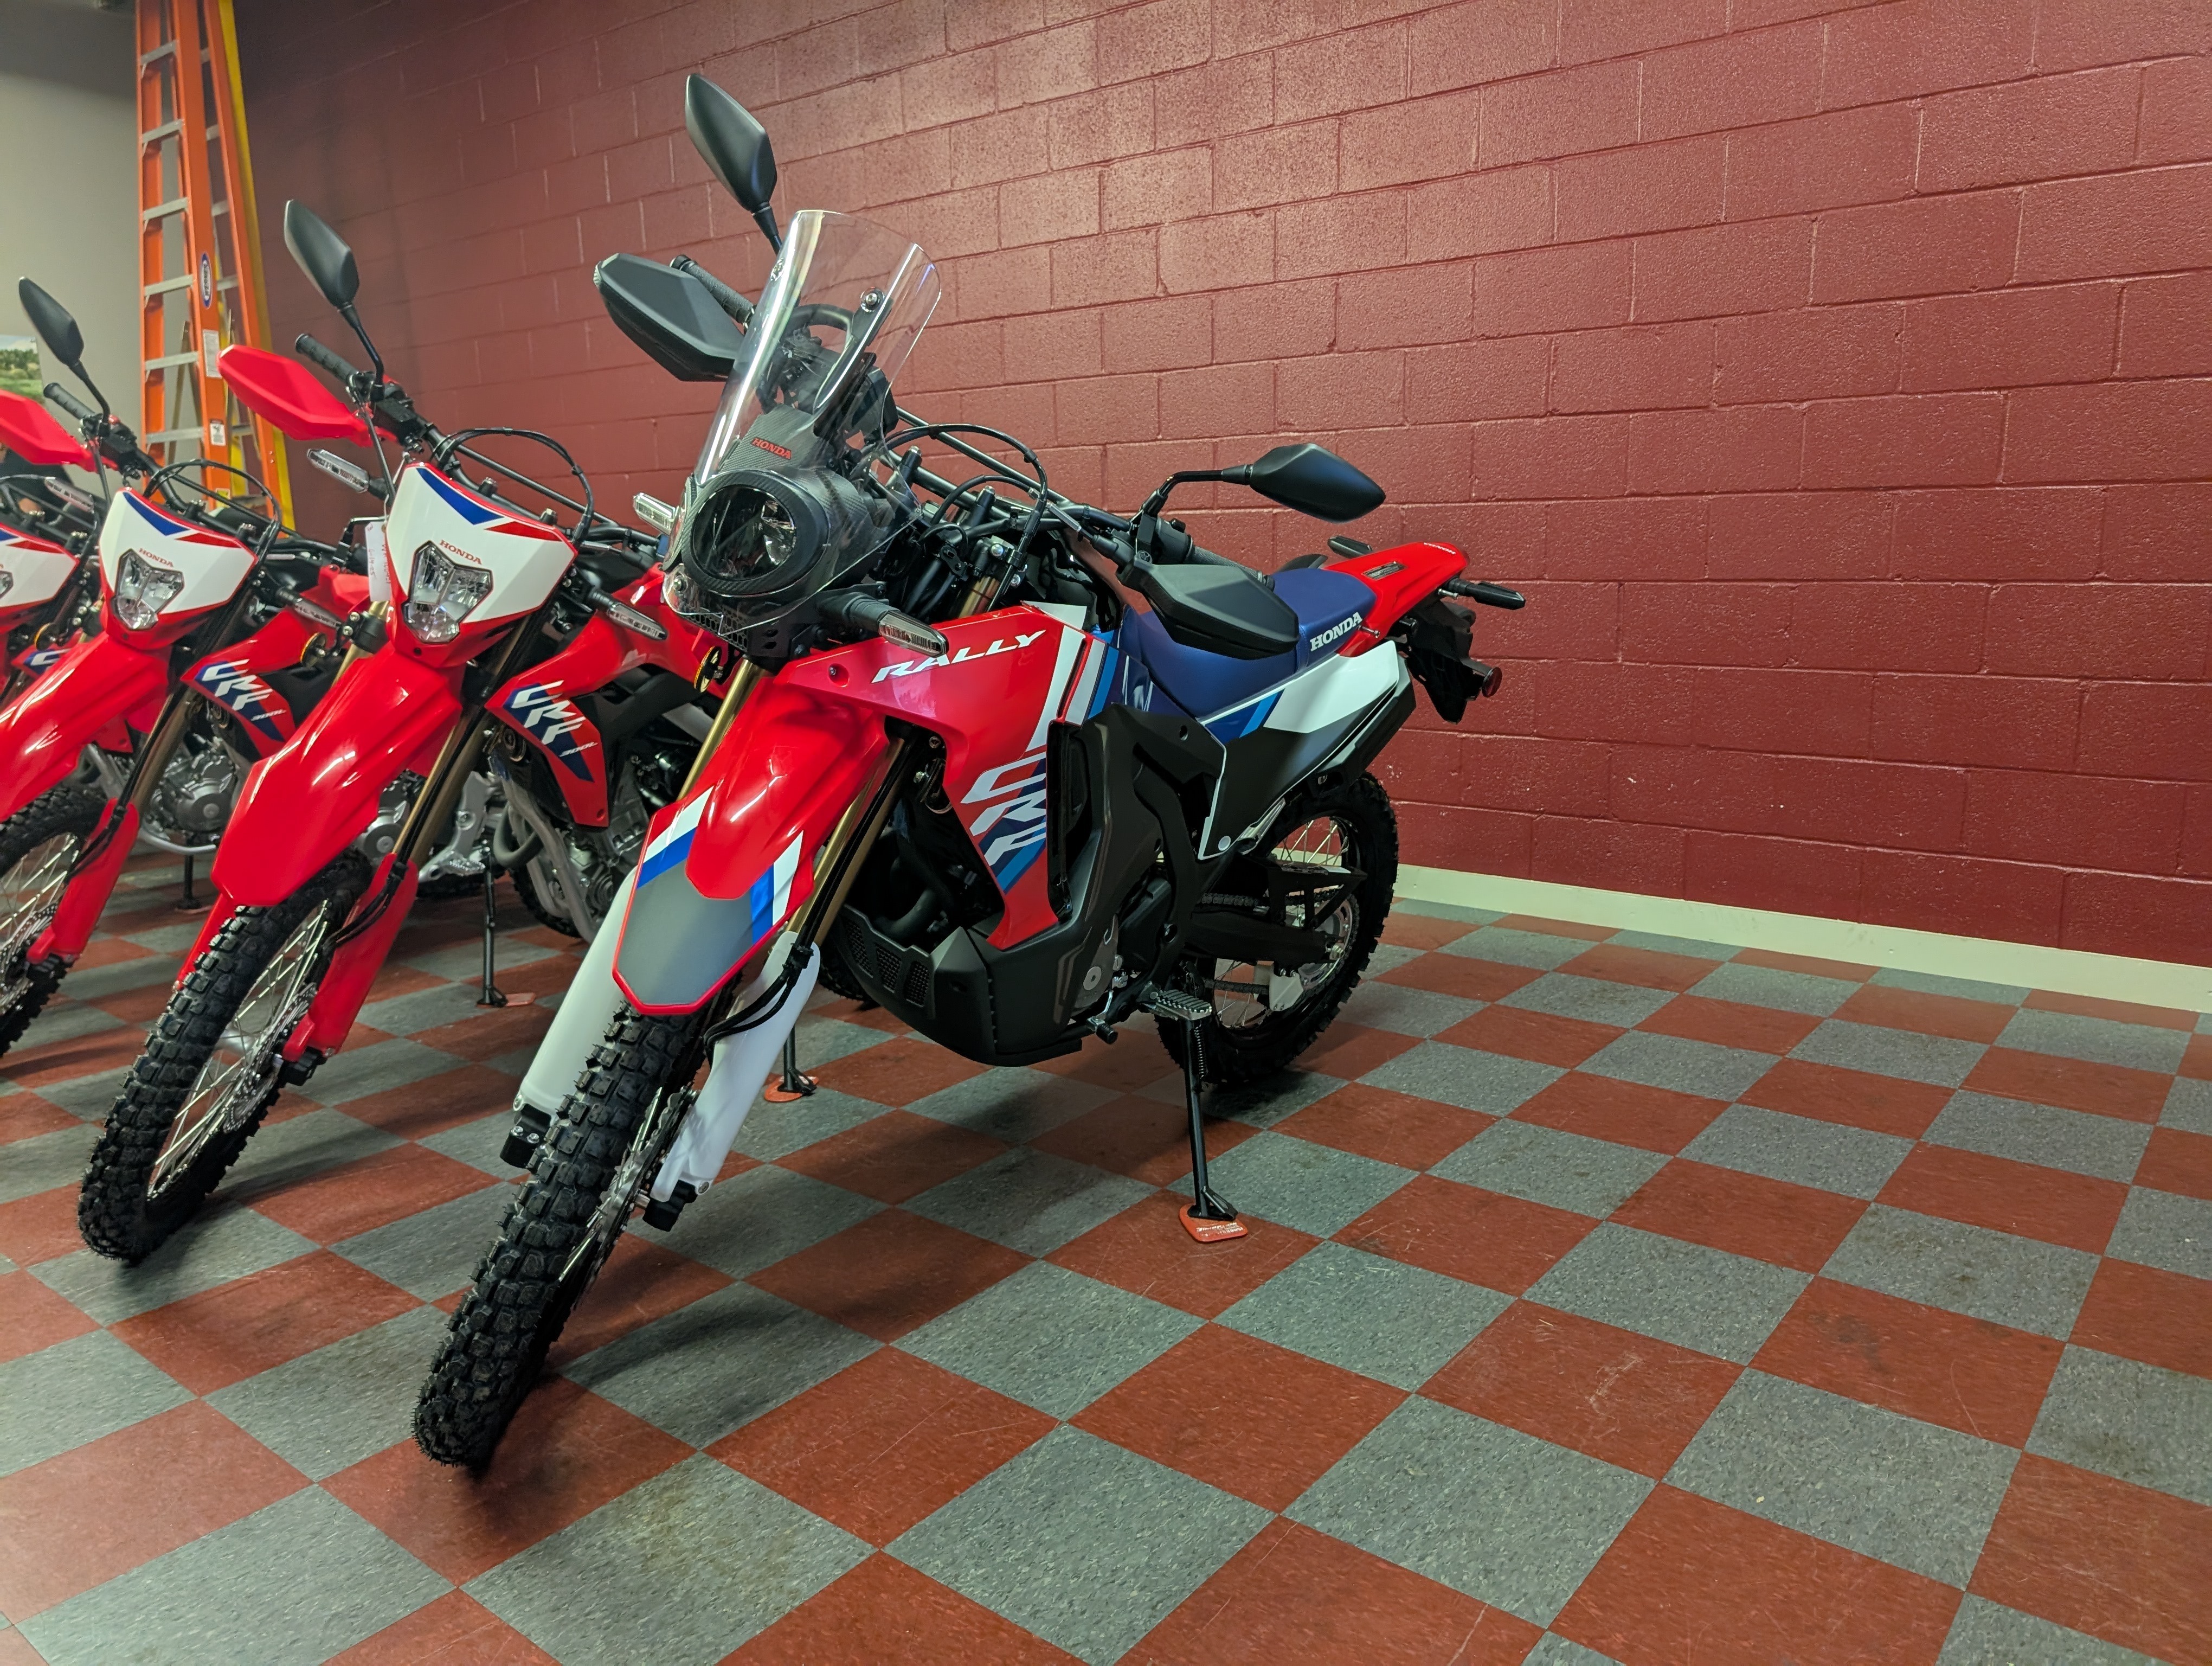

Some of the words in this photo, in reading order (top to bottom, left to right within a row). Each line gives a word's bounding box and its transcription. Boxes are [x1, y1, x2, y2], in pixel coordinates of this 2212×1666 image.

[752, 438, 791, 459] HONDA
[139, 548, 174, 567] HONDA
[440, 539, 482, 565] HONDA
[1309, 612, 1363, 652] HONDA
[871, 630, 1046, 683] RALLY
[511, 680, 586, 745] CRF
